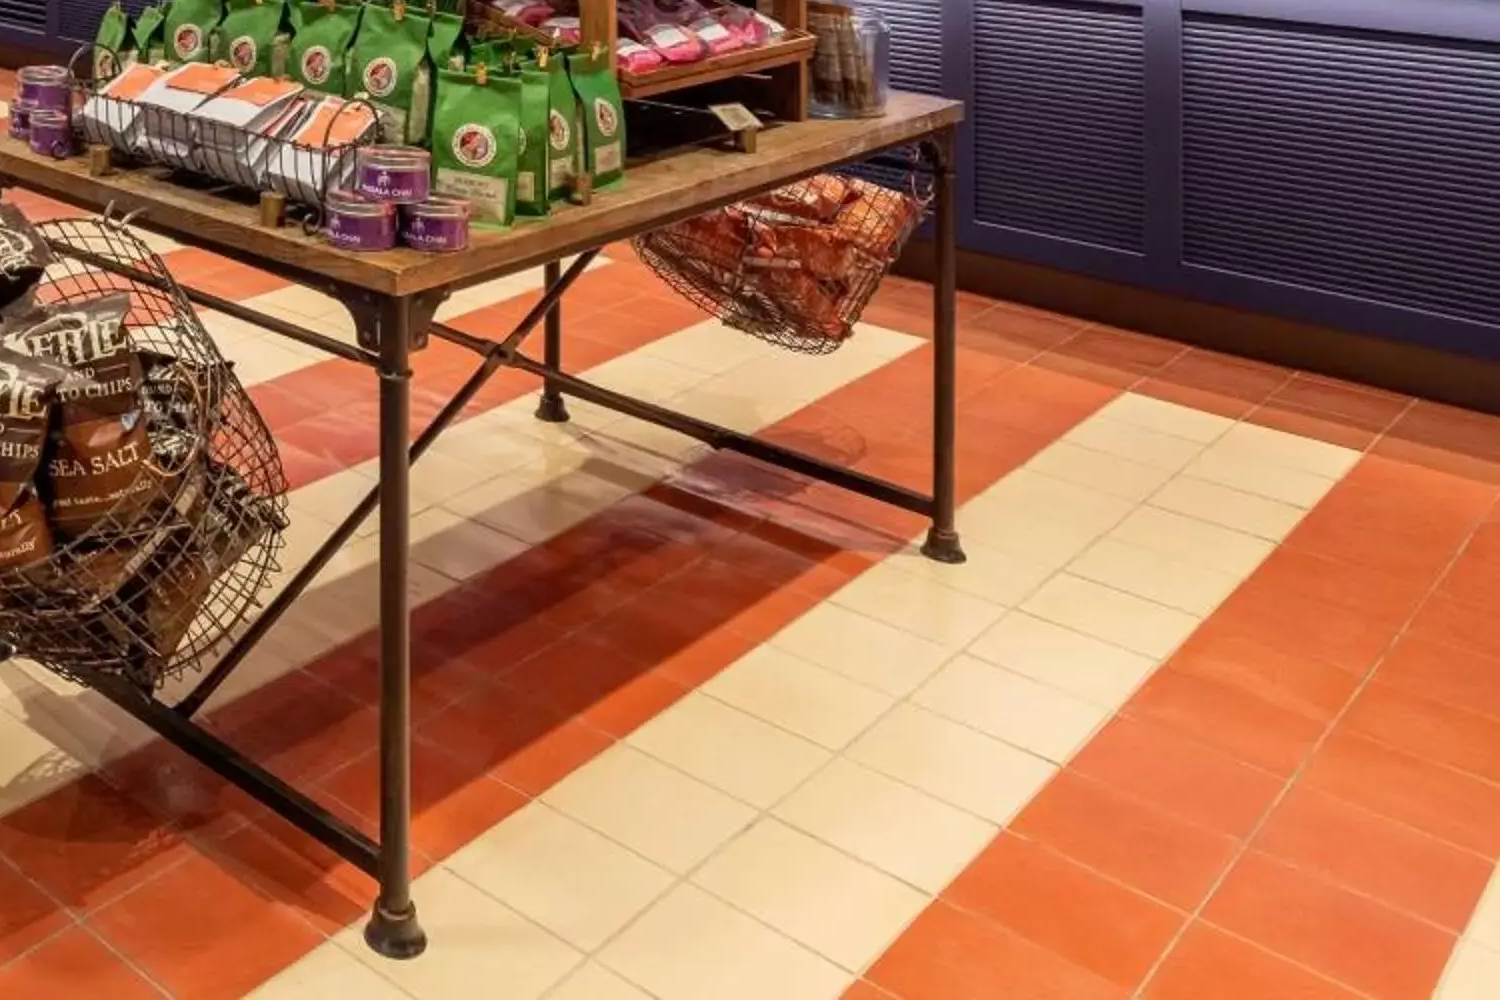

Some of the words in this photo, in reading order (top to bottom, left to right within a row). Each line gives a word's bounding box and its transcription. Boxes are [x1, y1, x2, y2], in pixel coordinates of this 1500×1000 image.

[3, 311, 130, 366] KETTLE
[64, 367, 96, 381] AND
[85, 377, 134, 398] CHIPS
[48, 459, 87, 477] SEA
[90, 441, 140, 475] SALT
